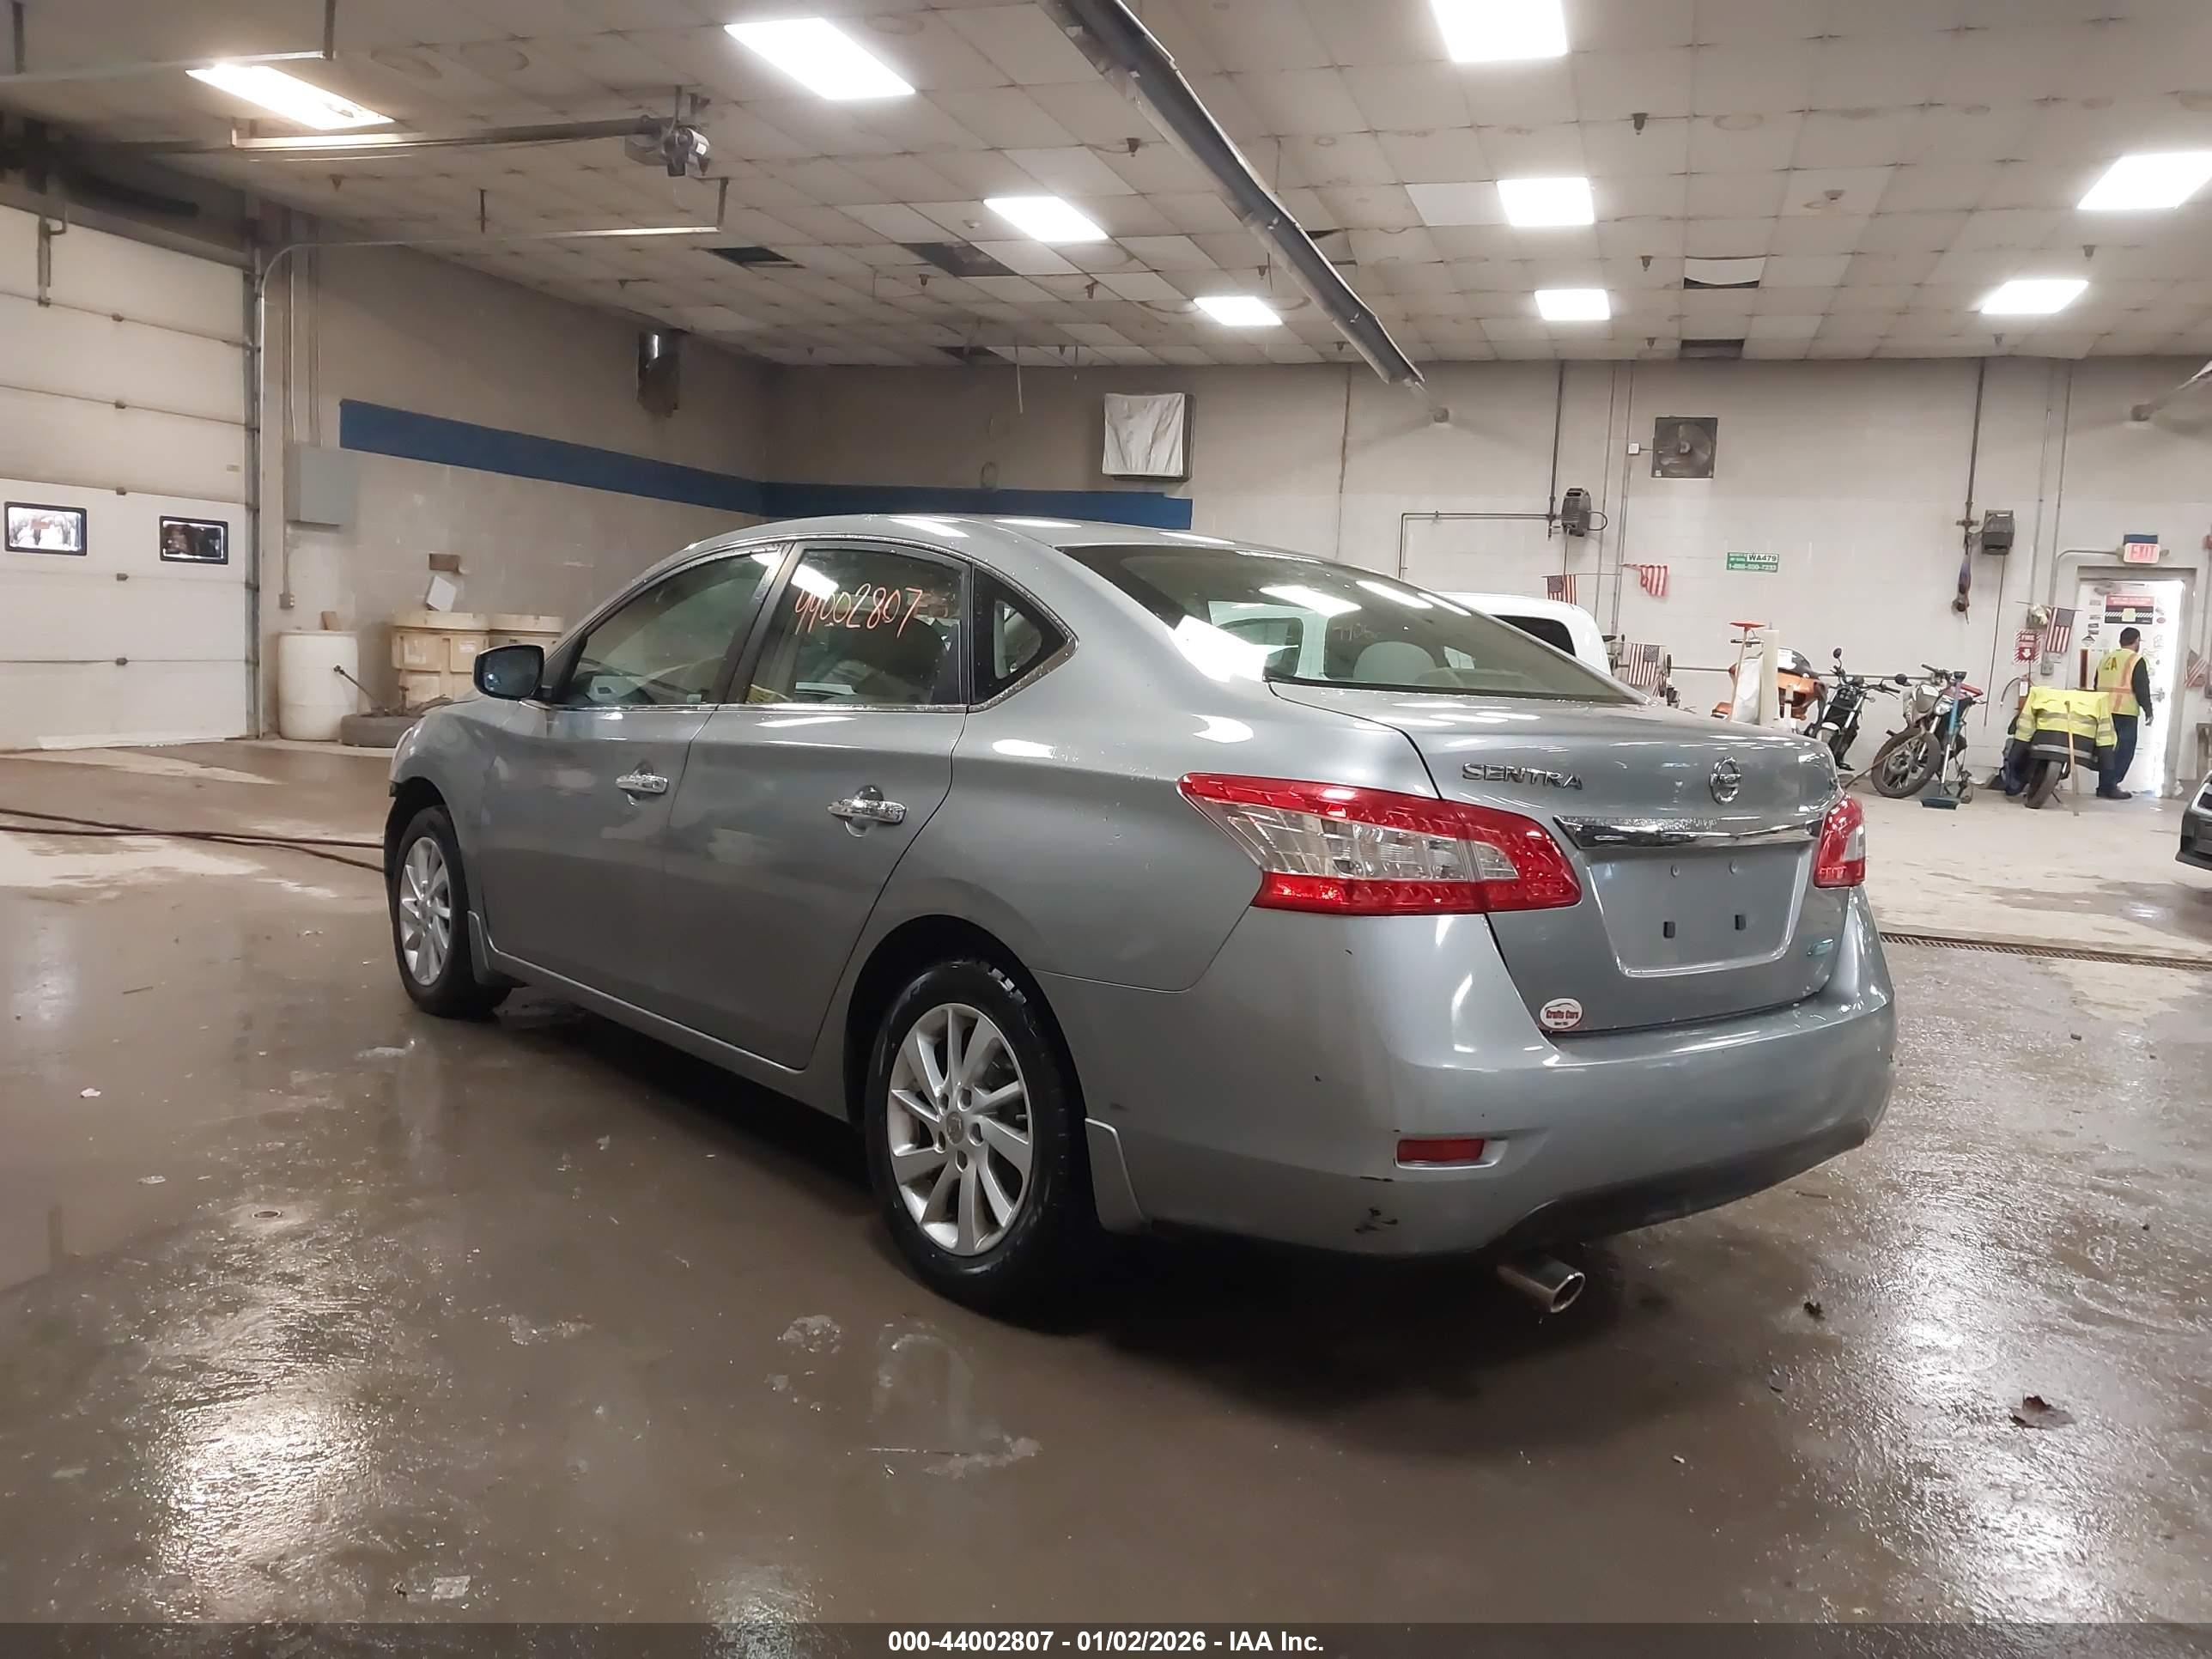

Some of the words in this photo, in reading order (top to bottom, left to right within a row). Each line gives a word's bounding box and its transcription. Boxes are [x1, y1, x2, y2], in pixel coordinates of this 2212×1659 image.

[2130, 544, 2157, 558] EXIT
[795, 583, 922, 638] 44002807
[1462, 763, 1583, 790] SENTRA
